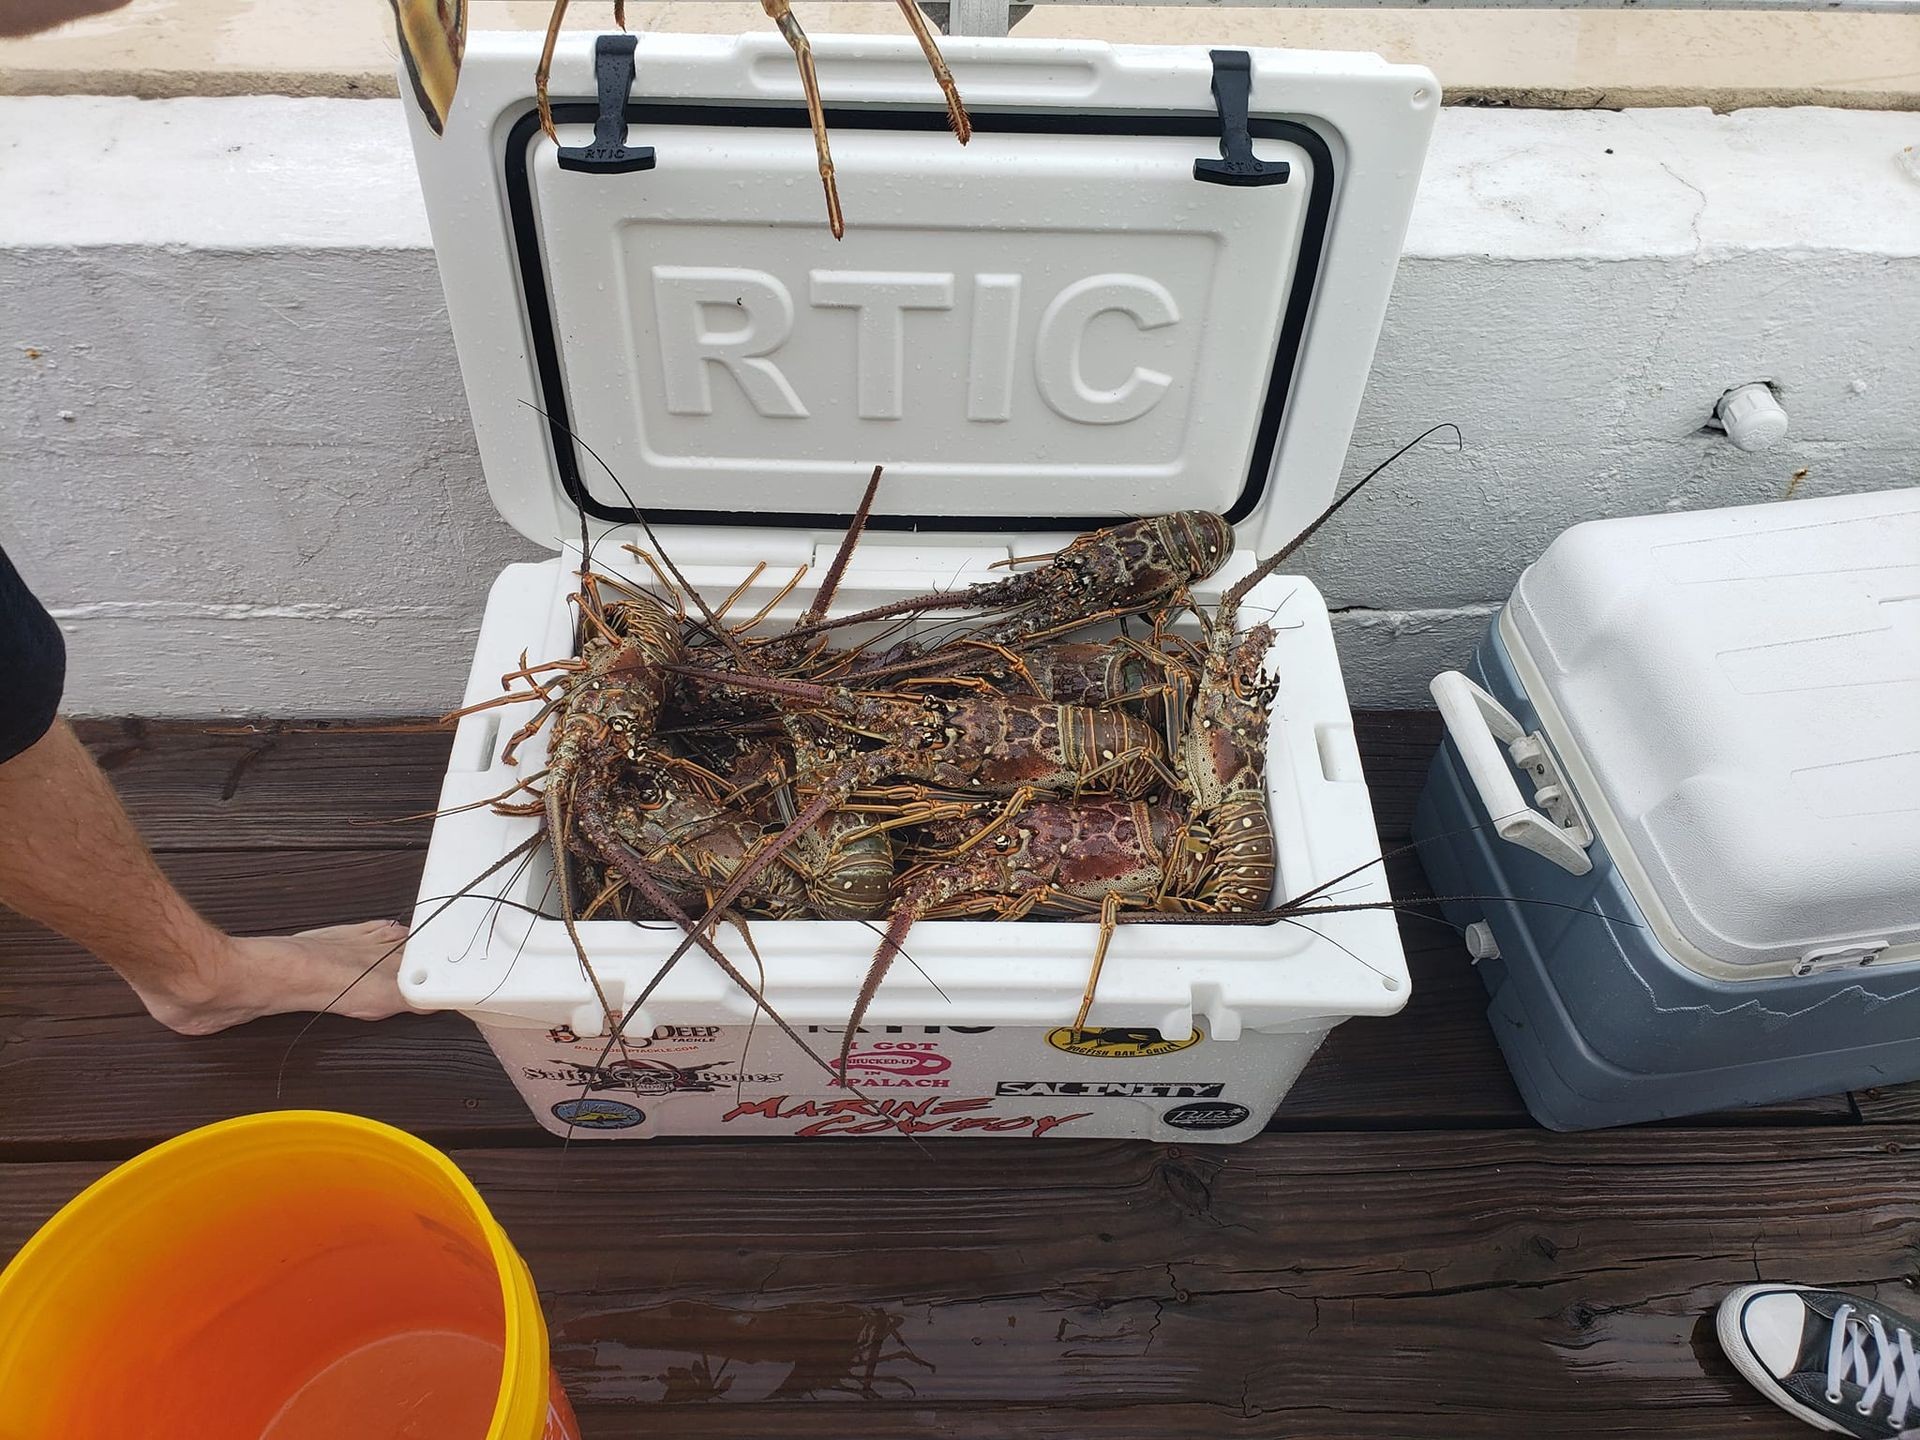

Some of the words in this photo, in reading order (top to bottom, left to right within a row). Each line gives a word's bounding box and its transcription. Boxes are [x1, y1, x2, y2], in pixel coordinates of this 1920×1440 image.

[585, 148, 625, 159] RTIC
[651, 263, 1183, 425] RTIC
[652, 1025, 720, 1041] DEEP
[872, 1042, 939, 1051] GOT
[1066, 1045, 1110, 1056] HOGFISH
[827, 1078, 951, 1087] APALACH
[998, 1082, 1222, 1097] SALINITY
[722, 1094, 997, 1123] MARINE
[794, 1111, 1095, 1138] COWBOY
